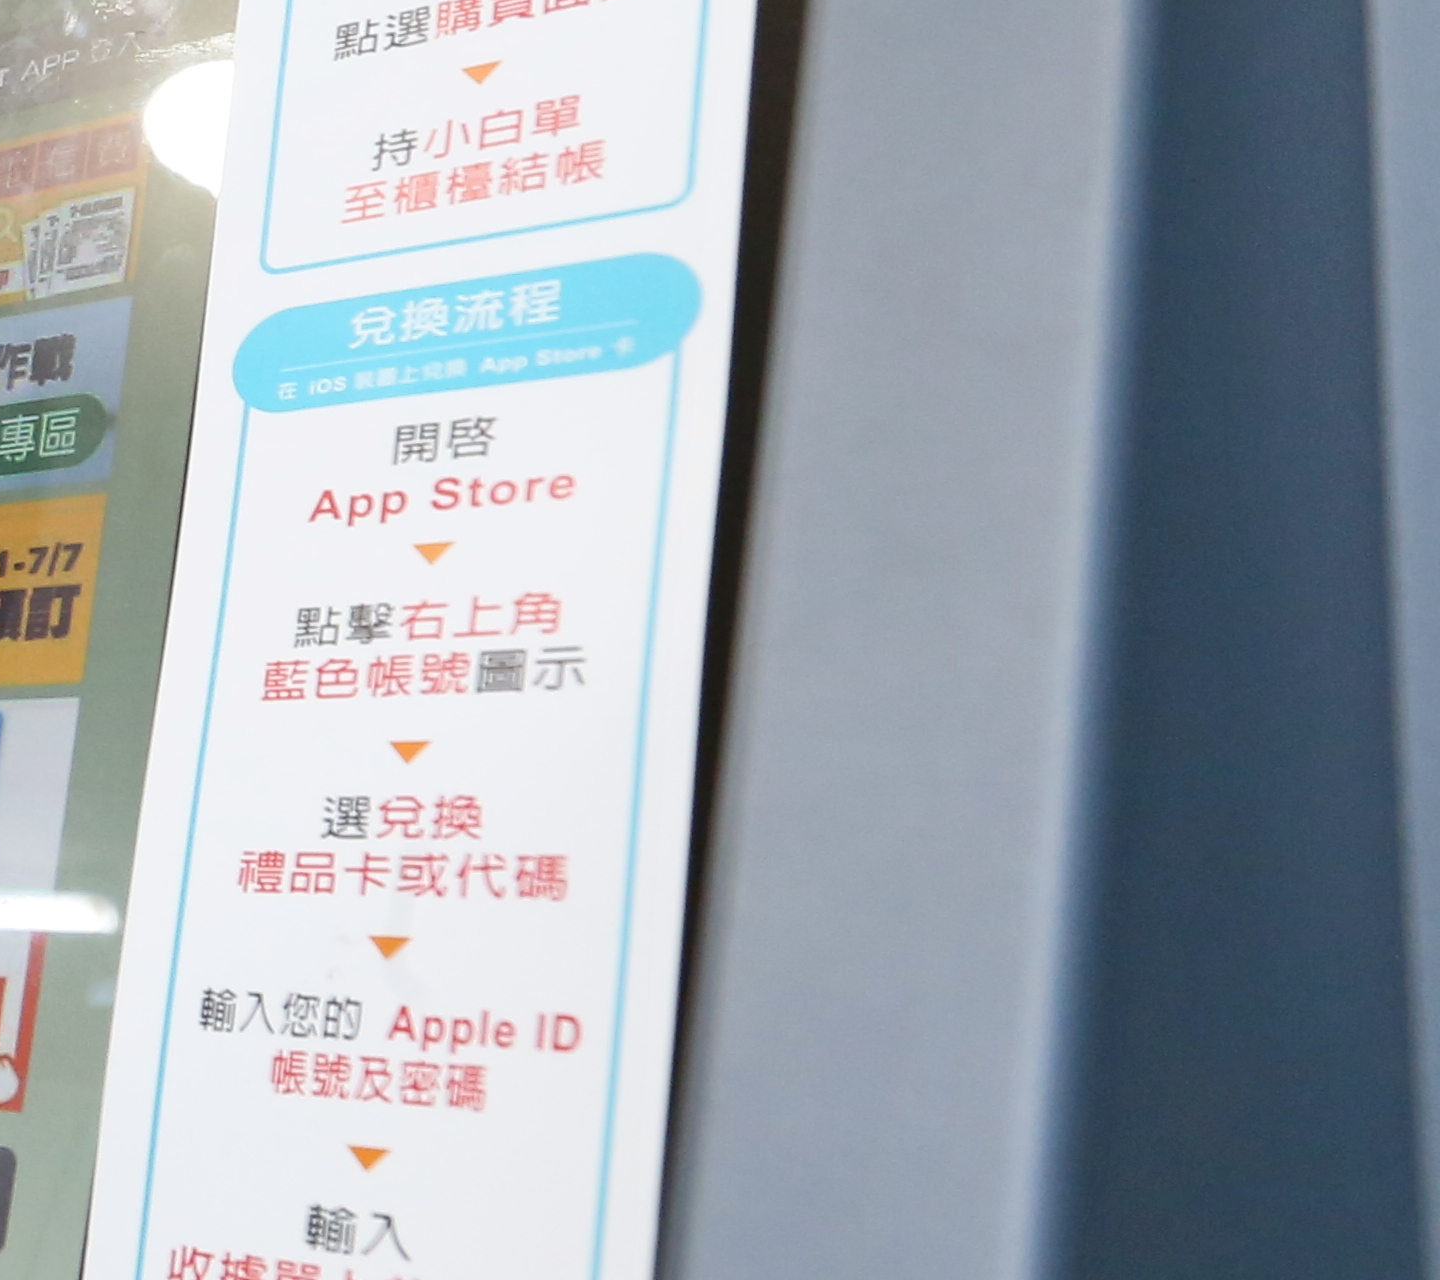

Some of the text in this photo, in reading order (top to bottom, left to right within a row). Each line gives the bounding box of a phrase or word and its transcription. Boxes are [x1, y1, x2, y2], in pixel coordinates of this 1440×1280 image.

[21, 49, 80, 83] APP
[370, 93, 583, 171] 持小白單
[349, 280, 562, 350] 兌換流程
[308, 375, 348, 396] iOS
[477, 354, 528, 375] App
[534, 345, 602, 367] Store
[309, 470, 578, 526] App Store
[293, 591, 562, 649] 點擊右上角
[261, 645, 586, 703] 藍色帳號圖示
[321, 793, 484, 840] 選兌換
[237, 849, 568, 902] 禮品卡或代碼
[198, 986, 582, 1053] 輸入您的 Apple ID
[270, 1052, 488, 1112] 帳號及密碼
[305, 1204, 411, 1261] 輸入
